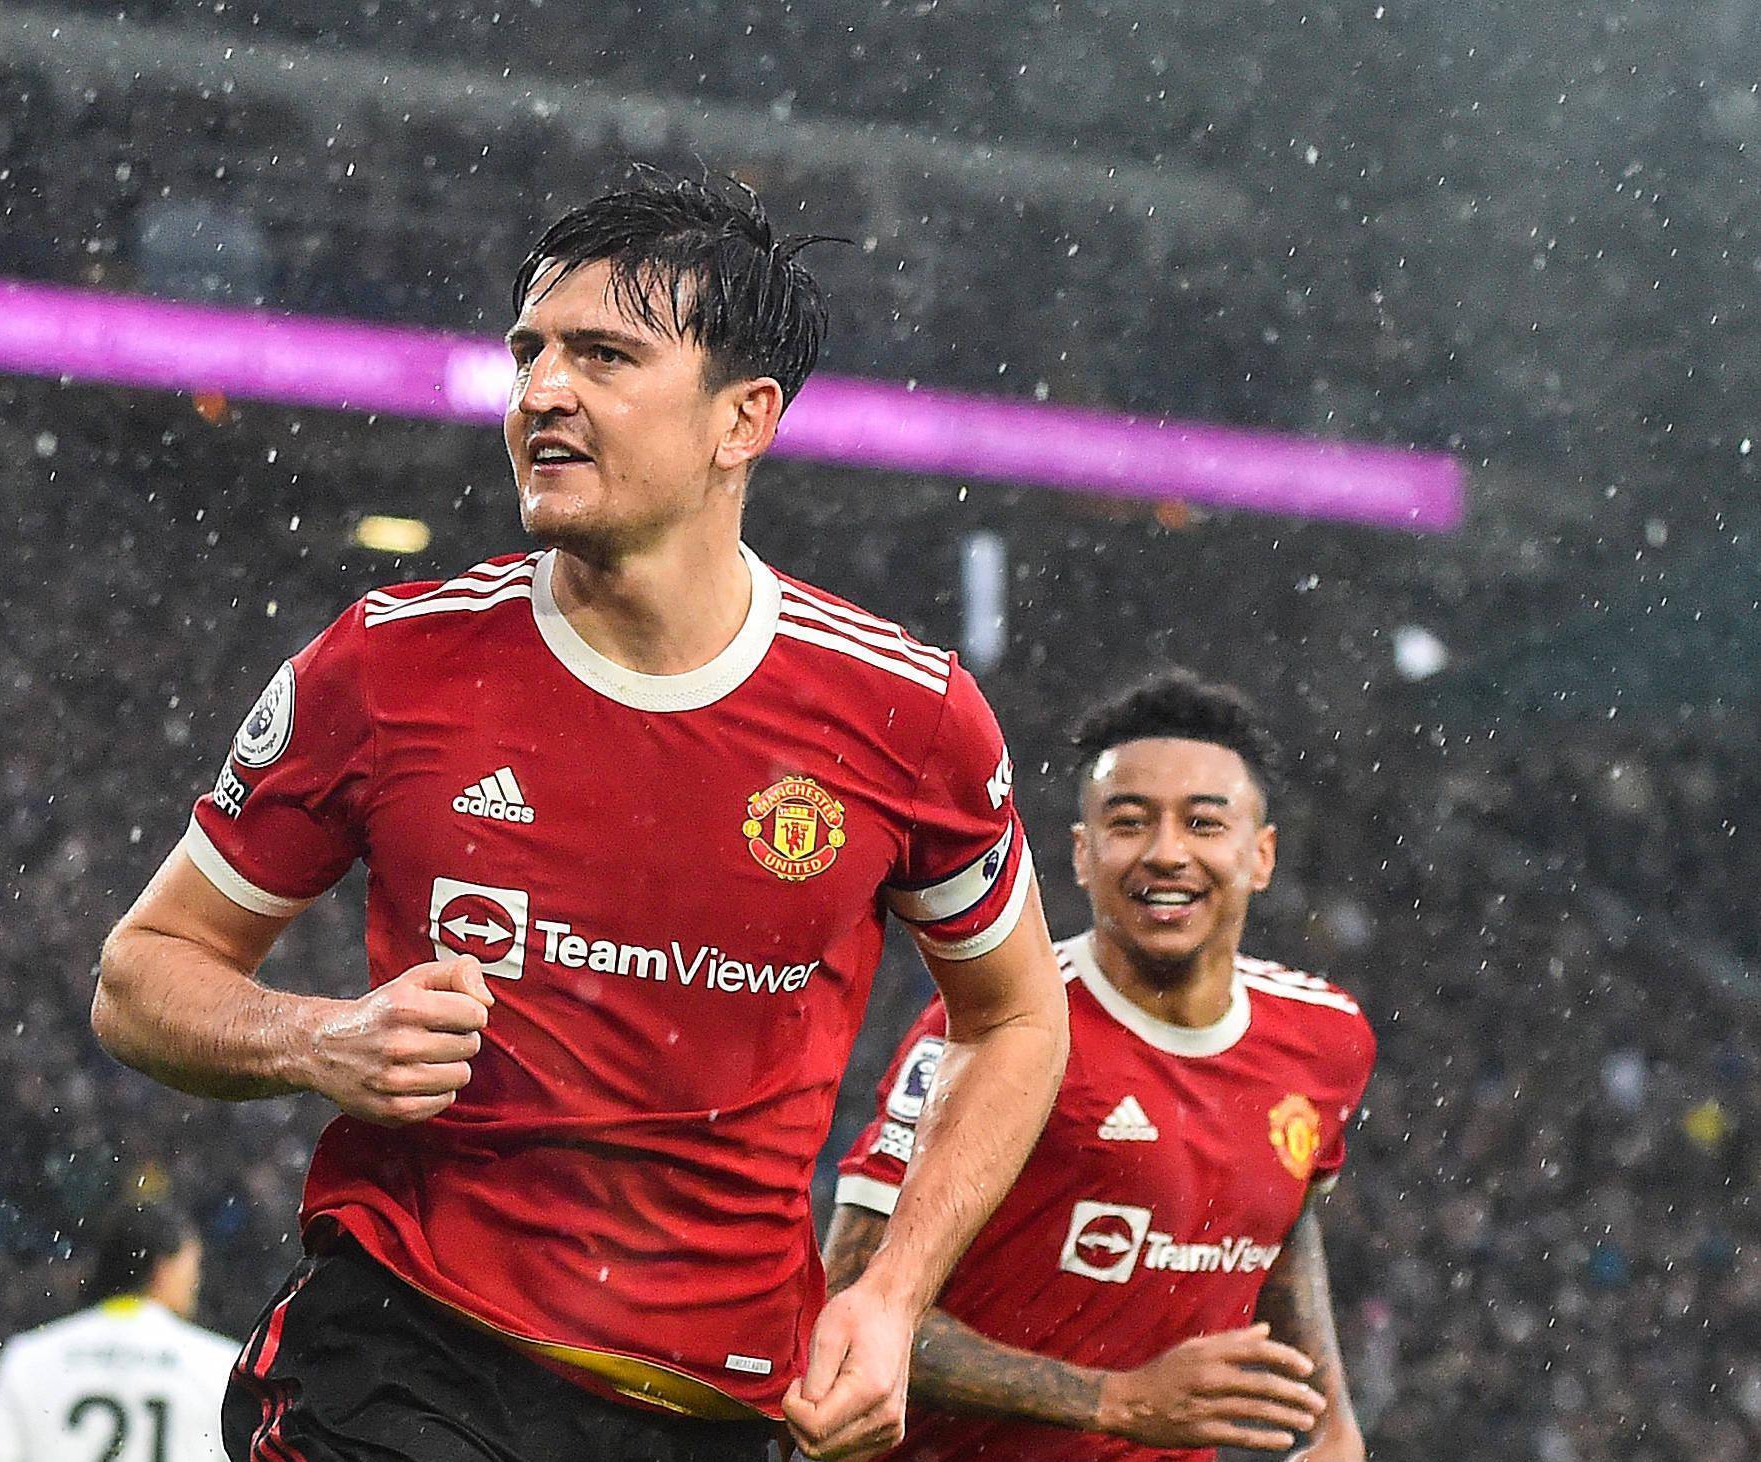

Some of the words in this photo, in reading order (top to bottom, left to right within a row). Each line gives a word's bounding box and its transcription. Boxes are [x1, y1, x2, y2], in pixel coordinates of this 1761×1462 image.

[452, 795, 536, 824] adidas
[755, 784, 838, 823] MANCHESTER
[764, 852, 822, 874] UNITED
[535, 920, 820, 993] TeamViewer
